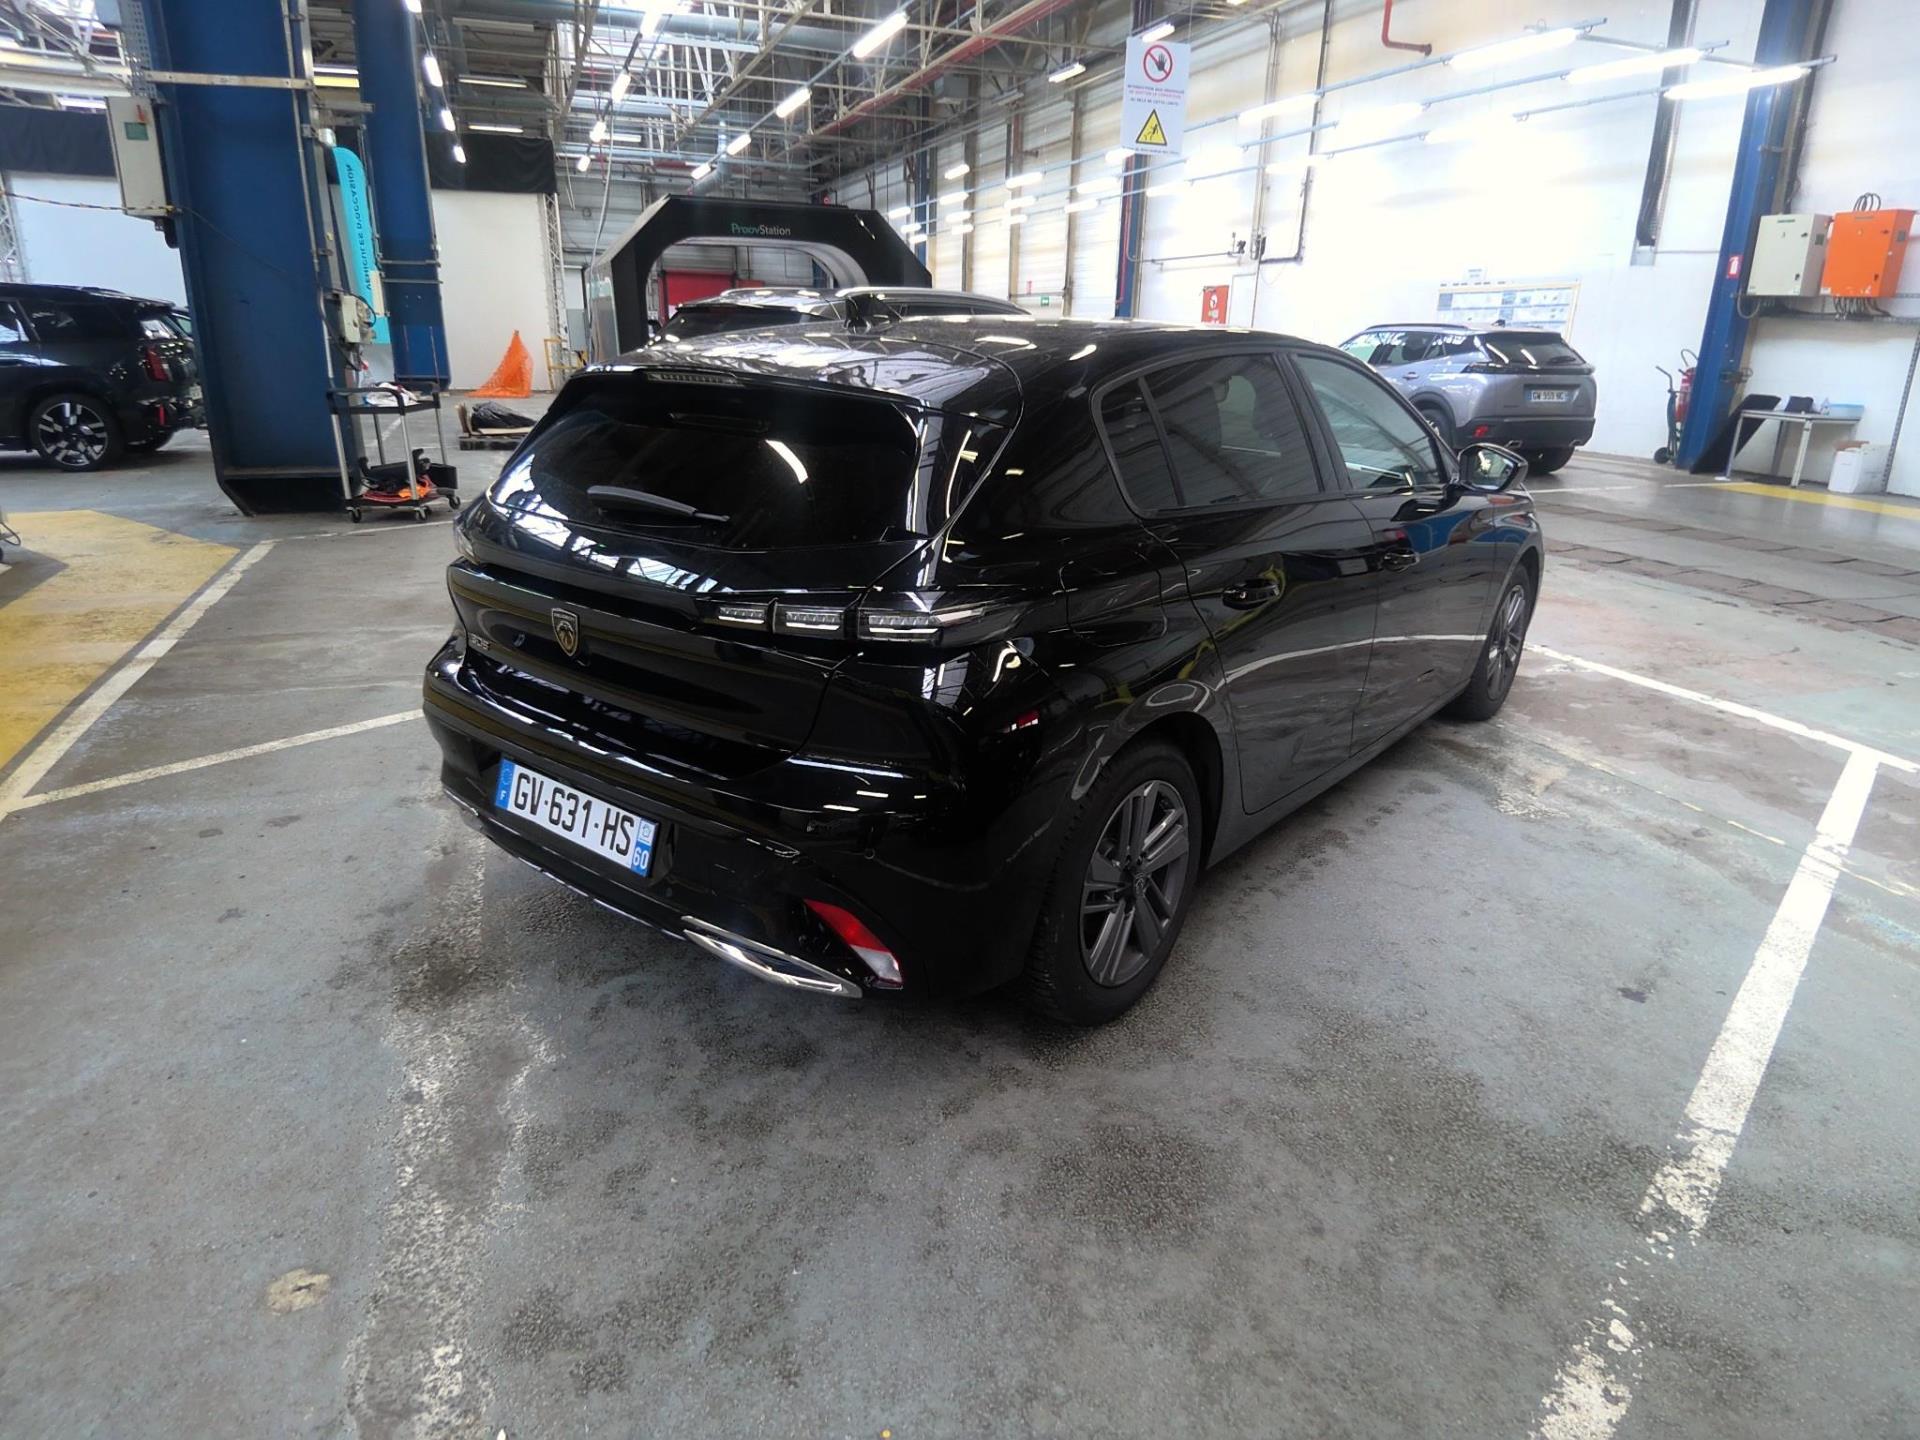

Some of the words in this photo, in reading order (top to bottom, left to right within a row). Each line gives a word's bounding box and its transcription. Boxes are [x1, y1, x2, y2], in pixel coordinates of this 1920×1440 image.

[731, 222, 791, 236] ProovStation
[514, 772, 635, 857] GV-631-HS
[633, 847, 650, 870] 60
